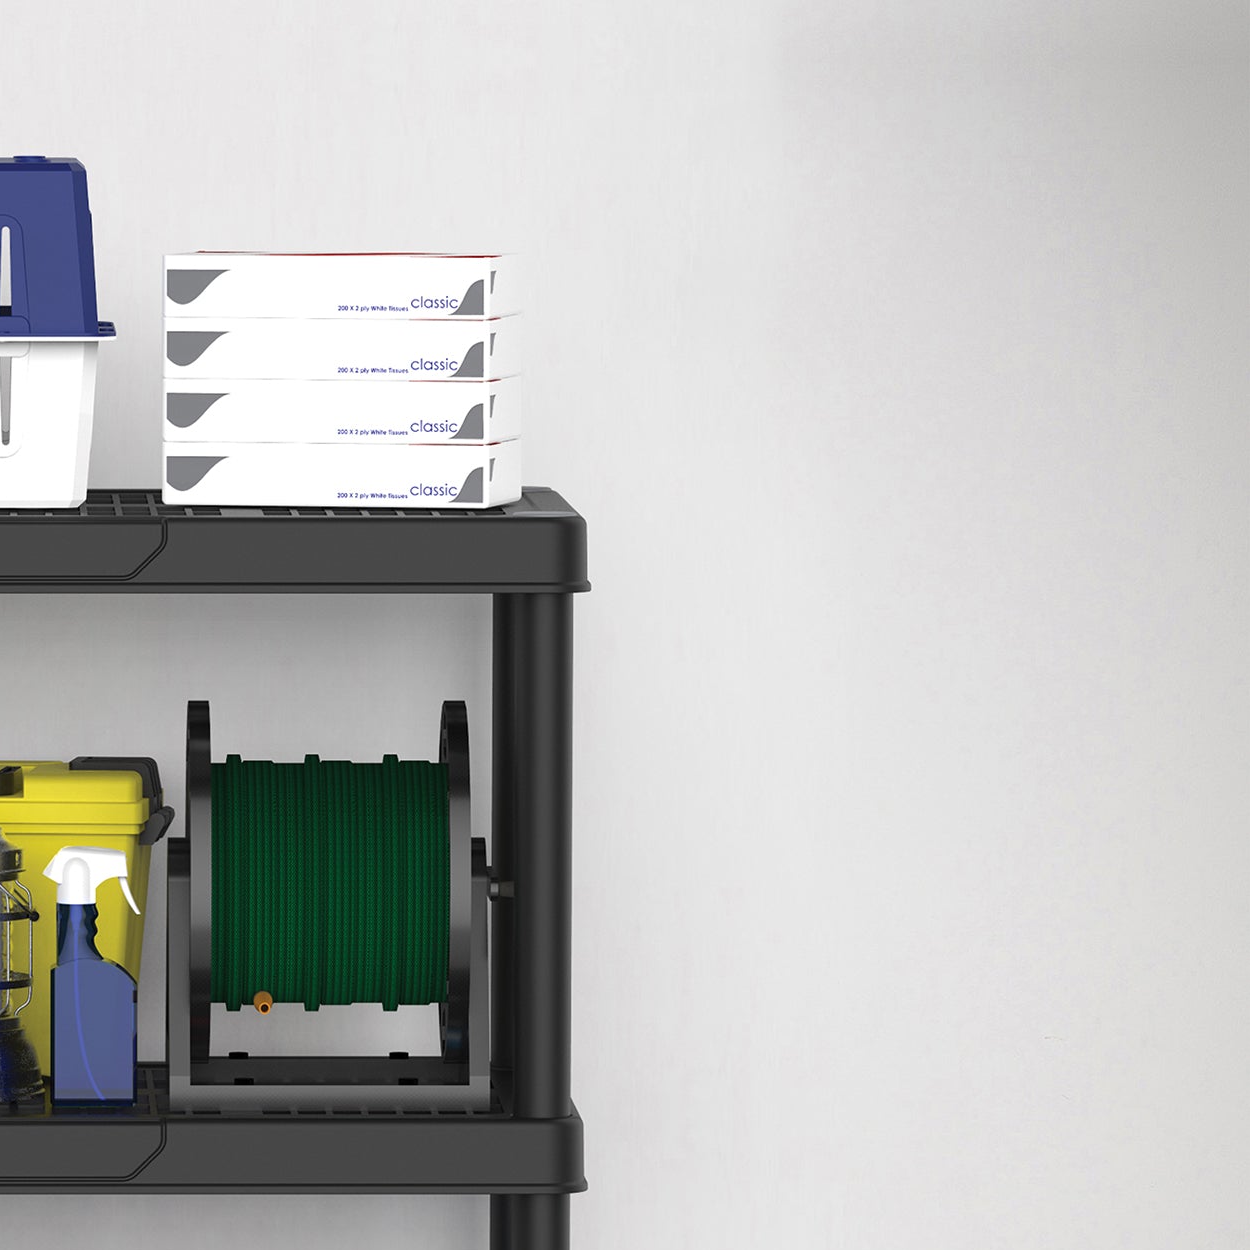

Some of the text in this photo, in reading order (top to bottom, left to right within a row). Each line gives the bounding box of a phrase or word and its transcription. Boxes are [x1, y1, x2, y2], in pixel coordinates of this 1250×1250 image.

[410, 296, 458, 309] classic
[410, 358, 458, 371] classic
[409, 420, 458, 432] classic
[409, 483, 458, 496] classic
